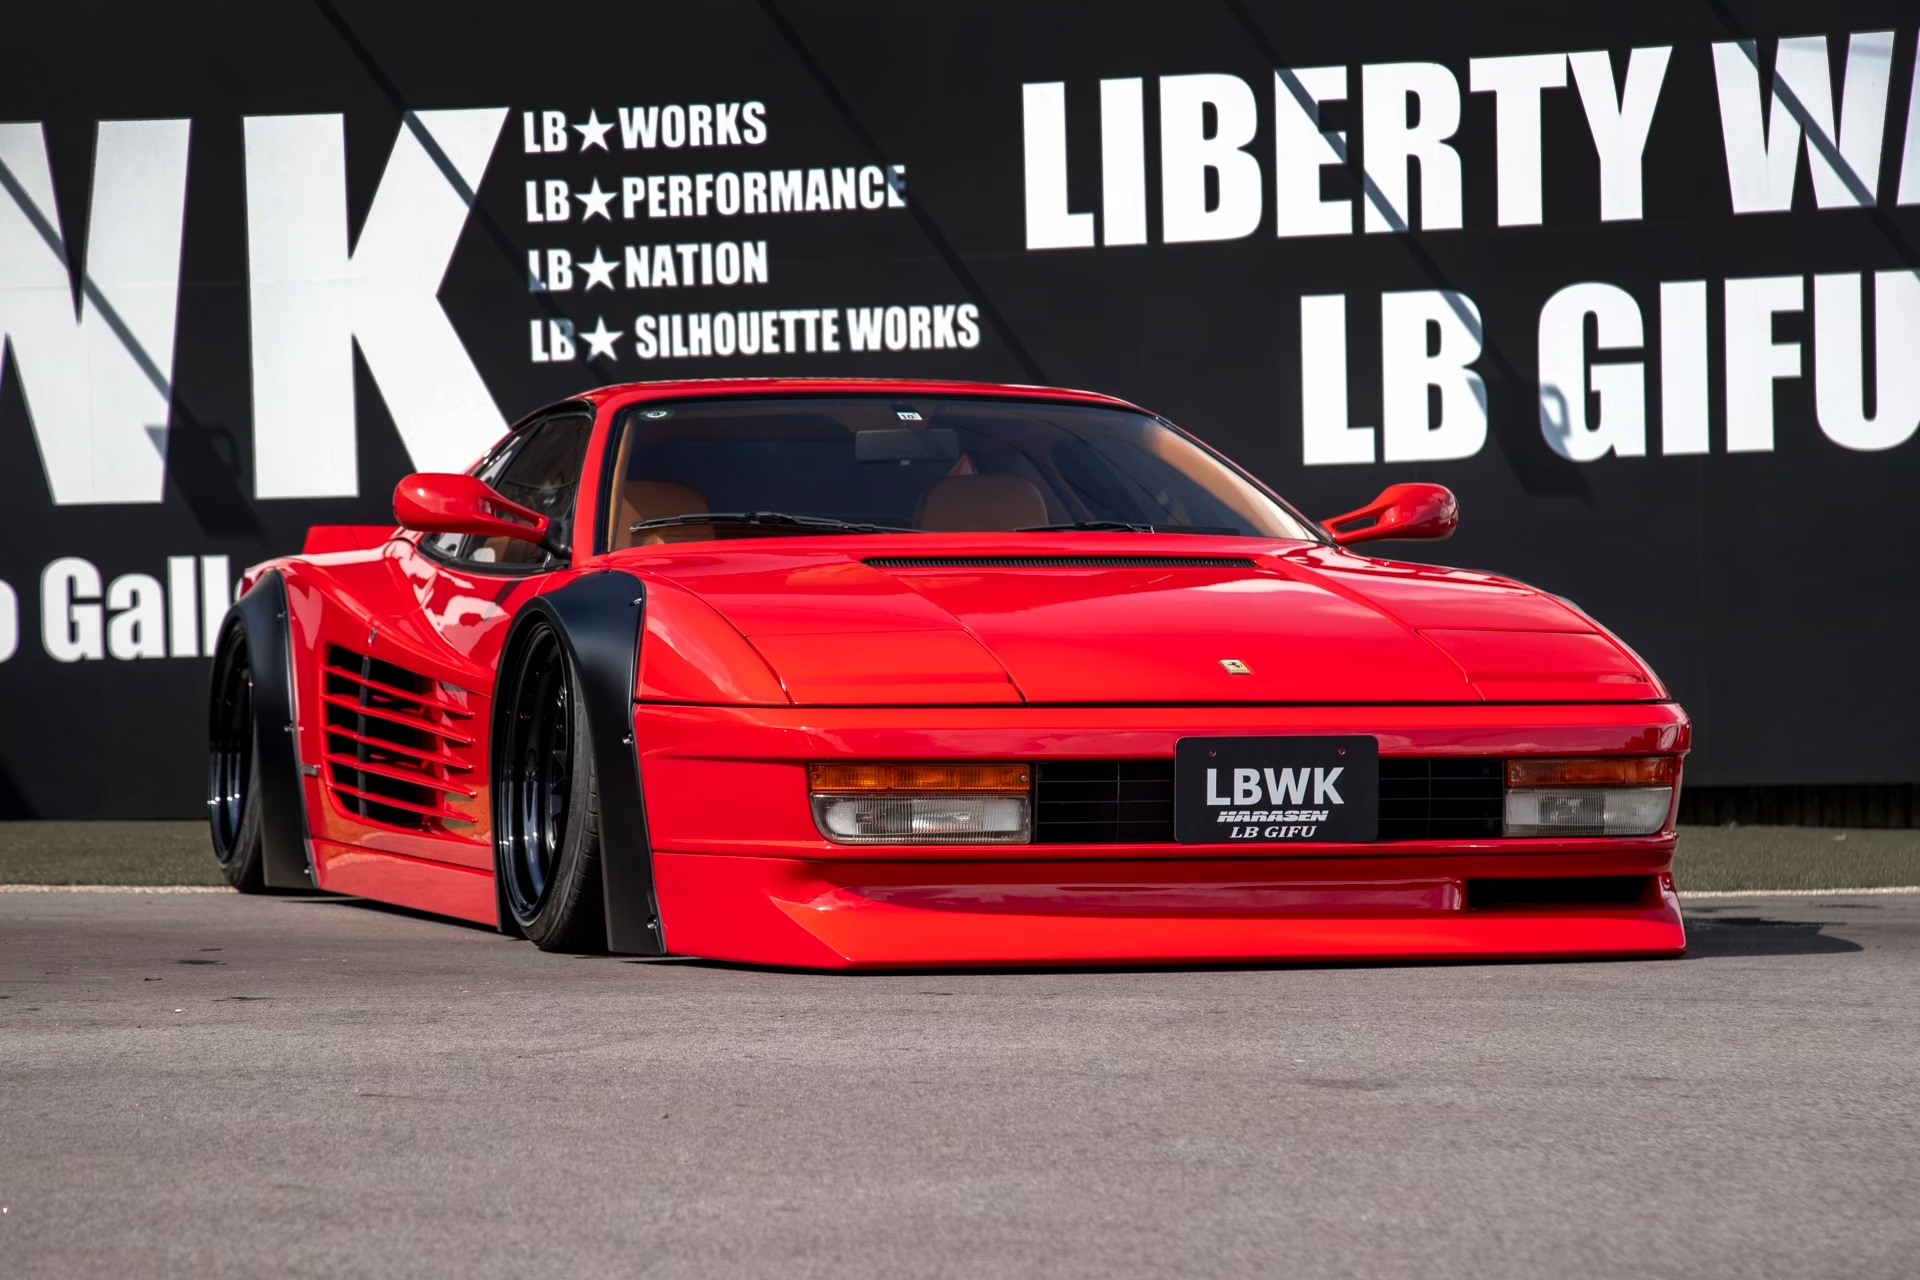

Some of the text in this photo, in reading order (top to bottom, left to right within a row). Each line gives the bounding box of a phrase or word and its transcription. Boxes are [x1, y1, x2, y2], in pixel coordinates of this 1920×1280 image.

[1022, 29, 1920, 250] LIBERTY W
[635, 309, 839, 359] SILHOUETTE
[846, 303, 980, 351] WORKS
[1300, 270, 1920, 466] LB GIFU
[41, 555, 238, 662] Gall
[1207, 767, 1344, 806] LBWK
[1217, 810, 1329, 822] HARASEN
[1230, 825, 1317, 839] LB GIFU
